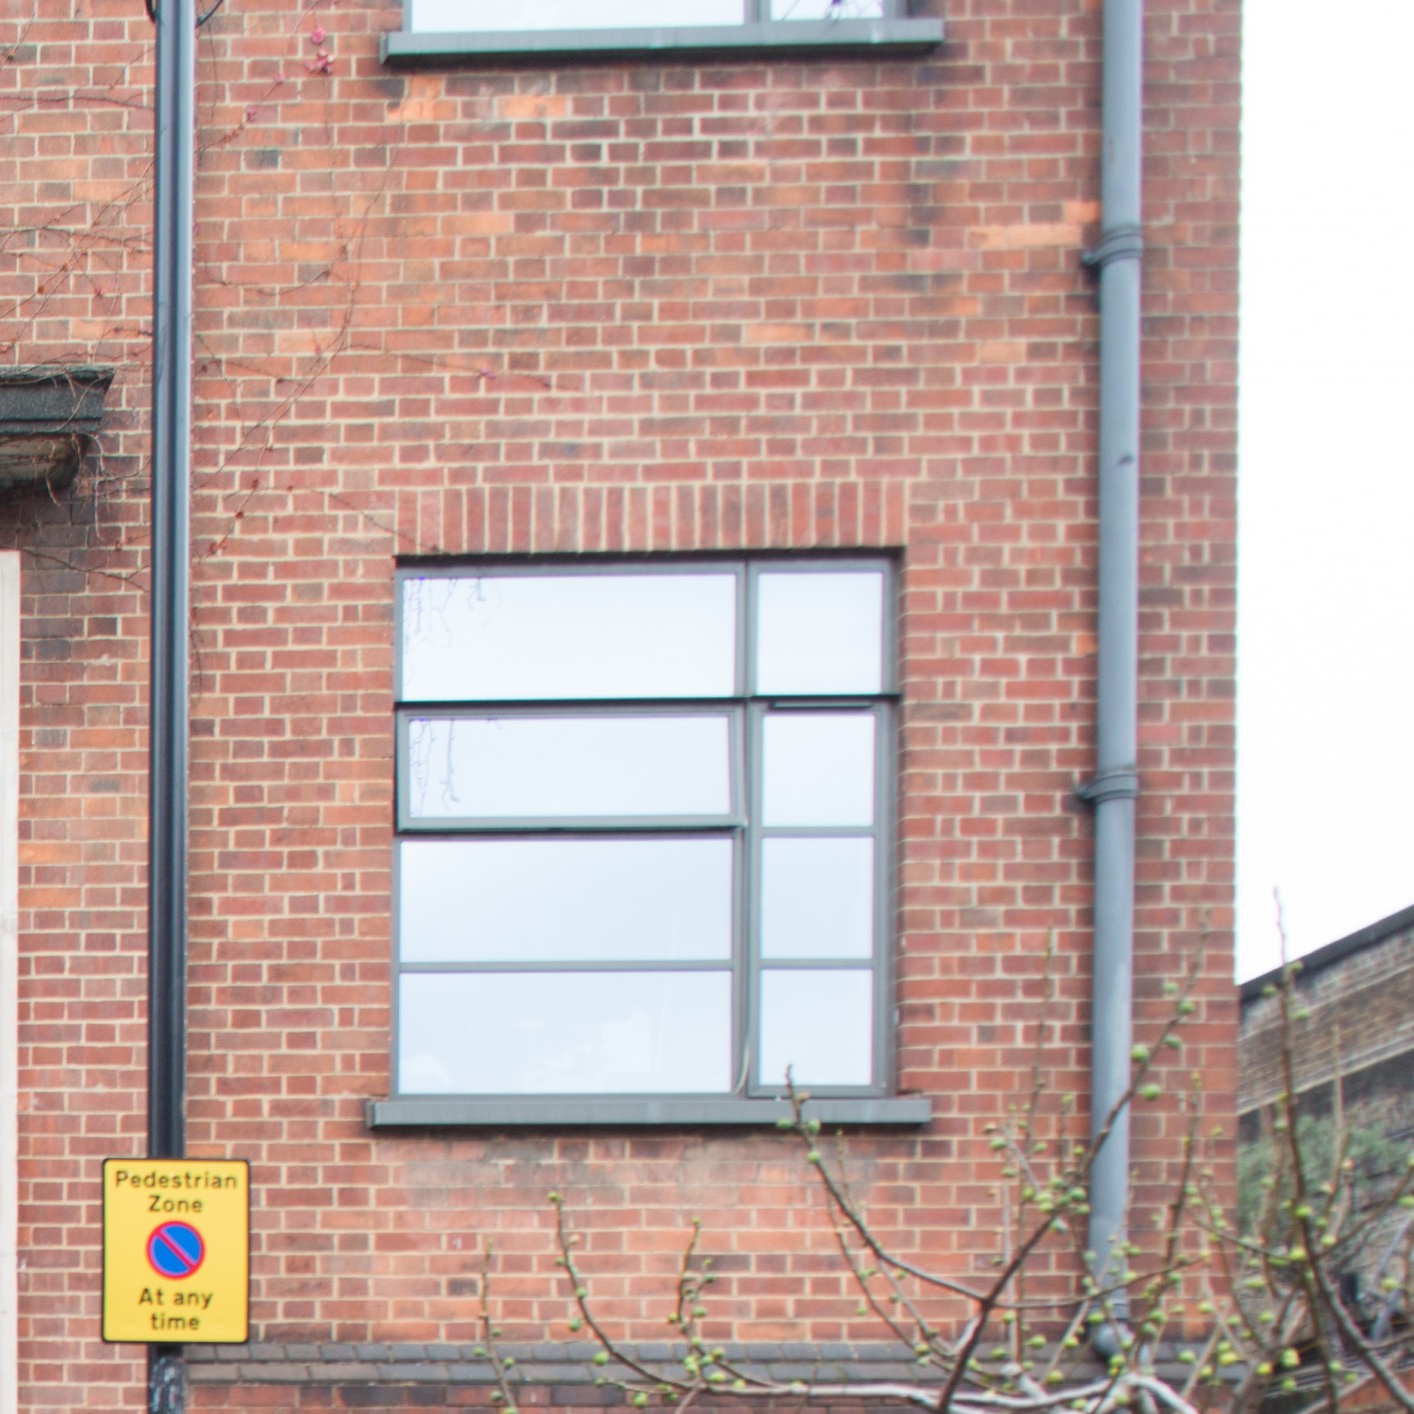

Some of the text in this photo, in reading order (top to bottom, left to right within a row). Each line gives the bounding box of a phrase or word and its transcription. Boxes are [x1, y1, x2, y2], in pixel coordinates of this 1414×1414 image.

[115, 1170, 237, 1190] Pedestrian
[148, 1195, 203, 1213] Zone
[138, 1288, 213, 1310] At any
[150, 1313, 200, 1331] time
